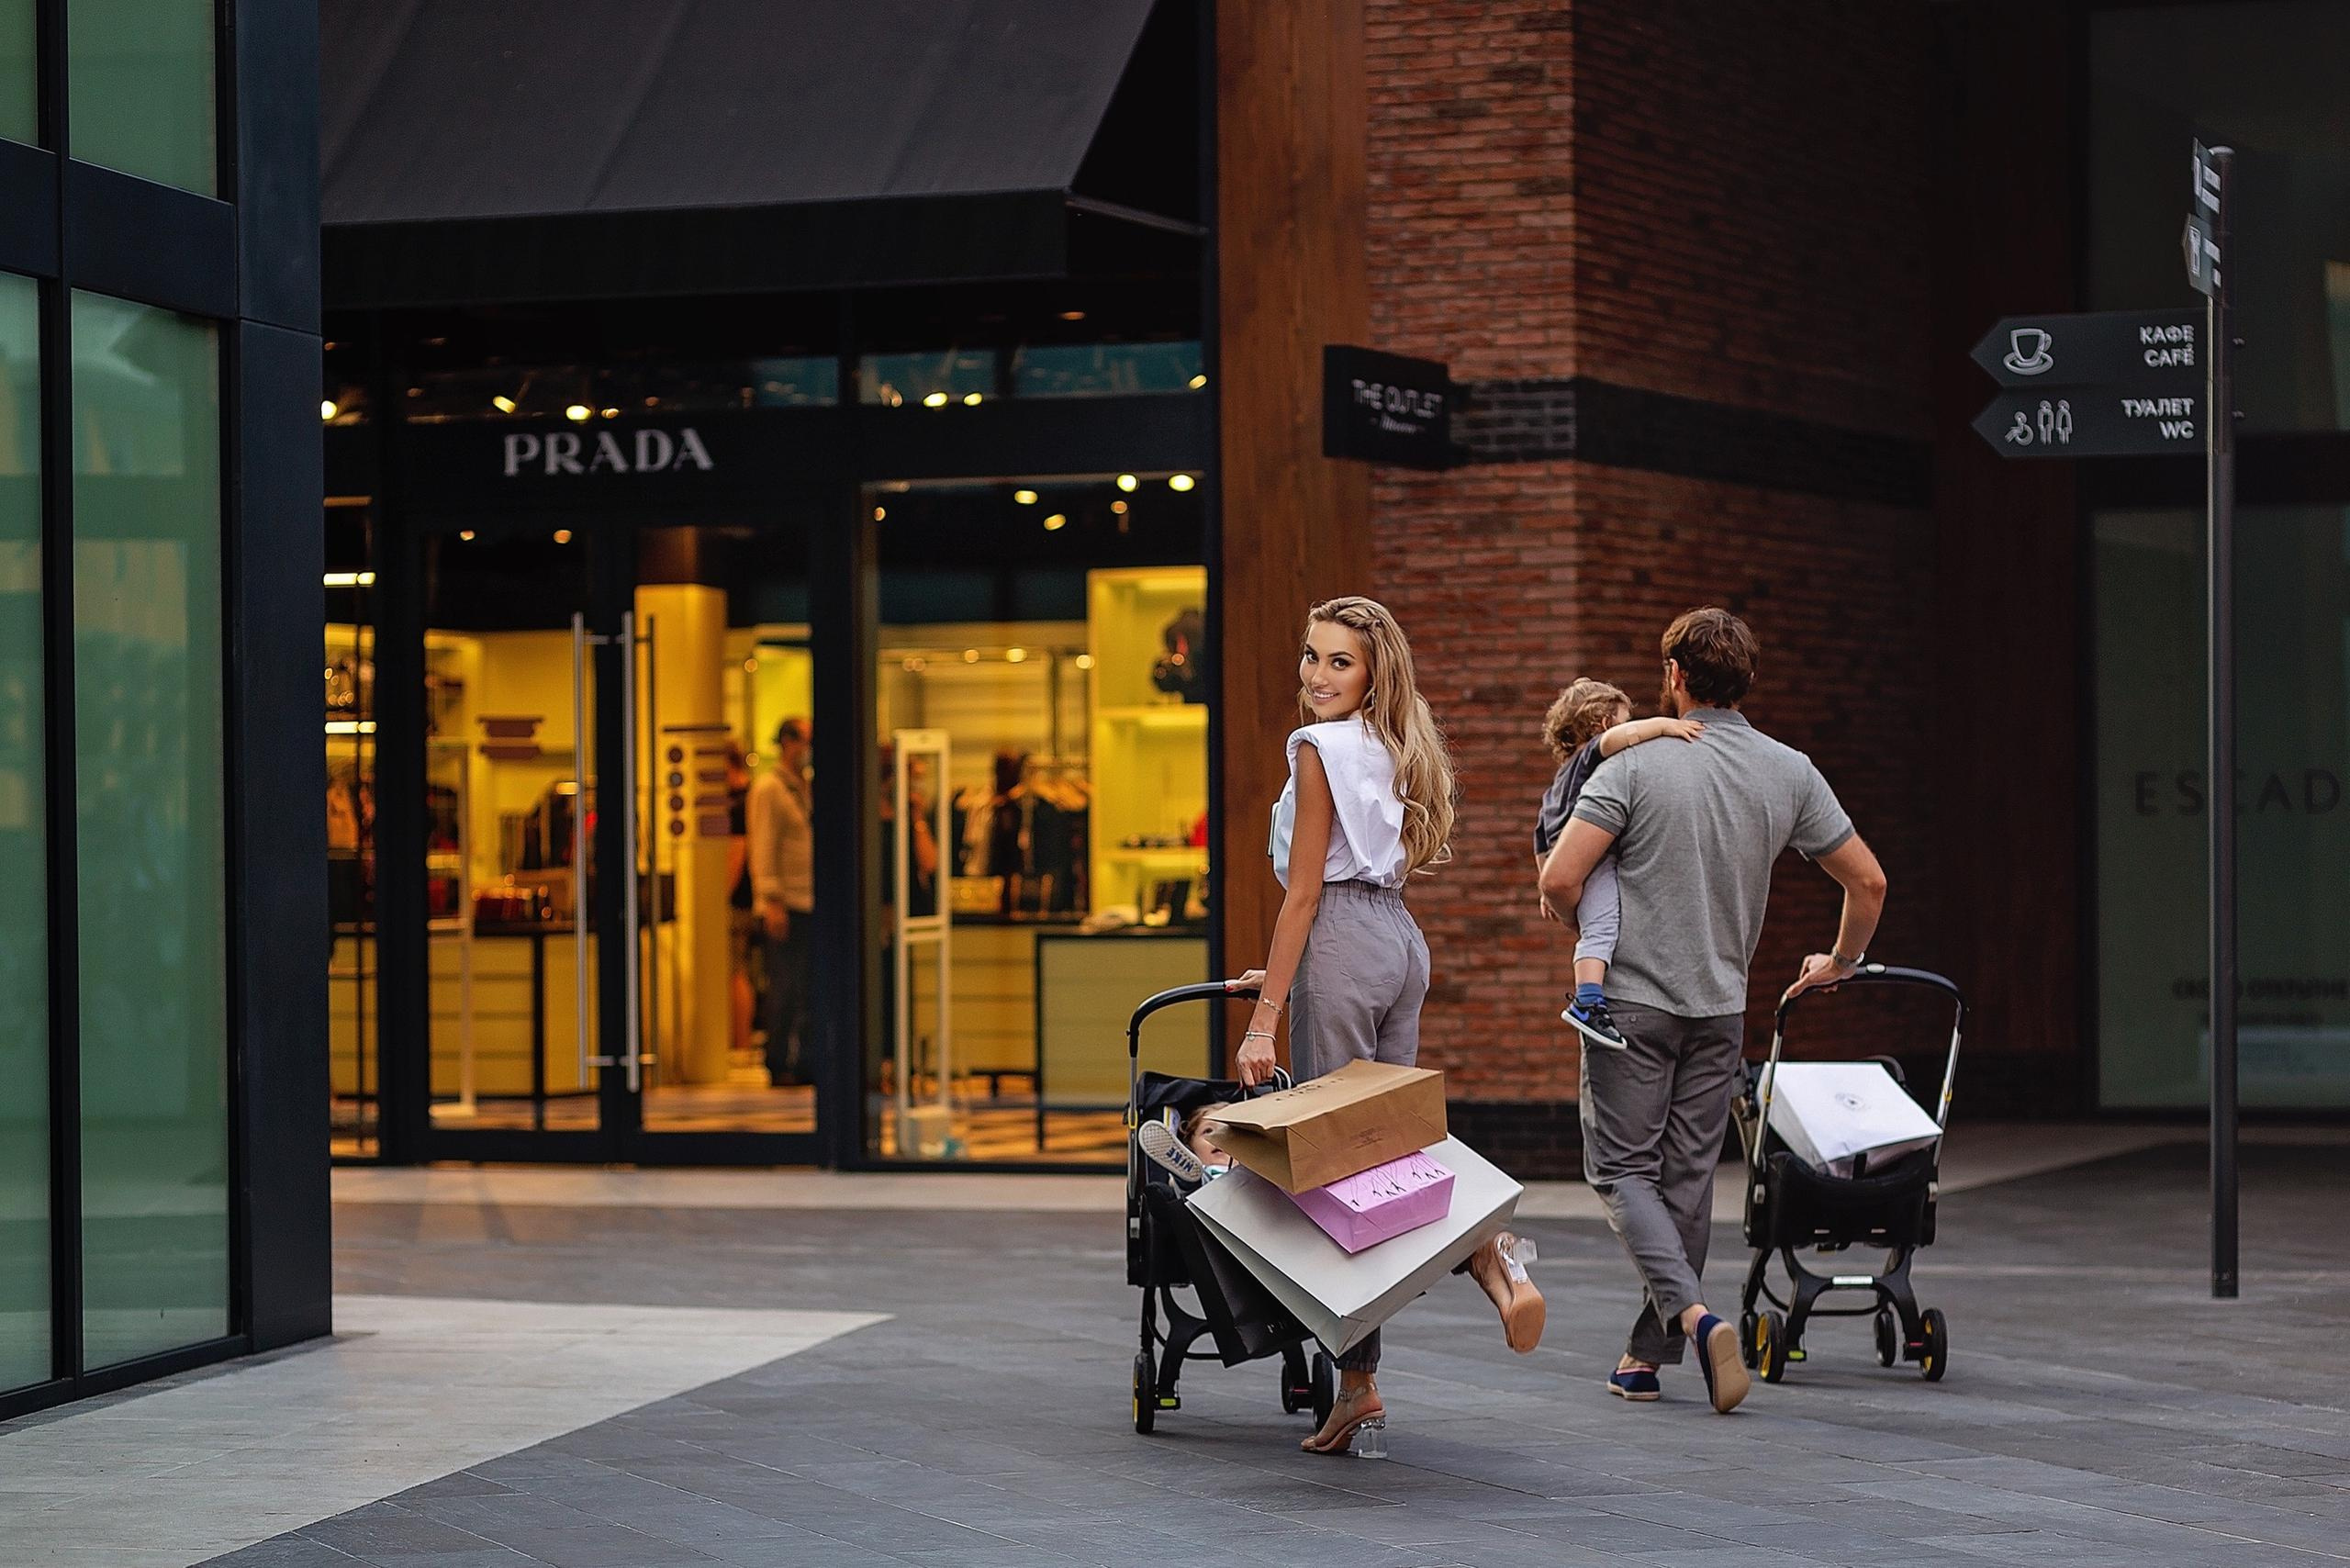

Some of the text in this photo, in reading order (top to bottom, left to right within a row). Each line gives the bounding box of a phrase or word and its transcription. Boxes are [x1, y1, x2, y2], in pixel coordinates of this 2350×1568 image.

[2139, 324, 2195, 344] КАФЕ
[2143, 342, 2195, 367] CAFÉ
[1351, 379, 1443, 420] THE OUTLET
[2121, 398, 2195, 419] ТУАЛЕТ
[2158, 420, 2195, 441] WC
[504, 428, 715, 476] PRADA
[2134, 768, 2342, 816] ESAD
[1166, 1147, 1194, 1172] NIKE
